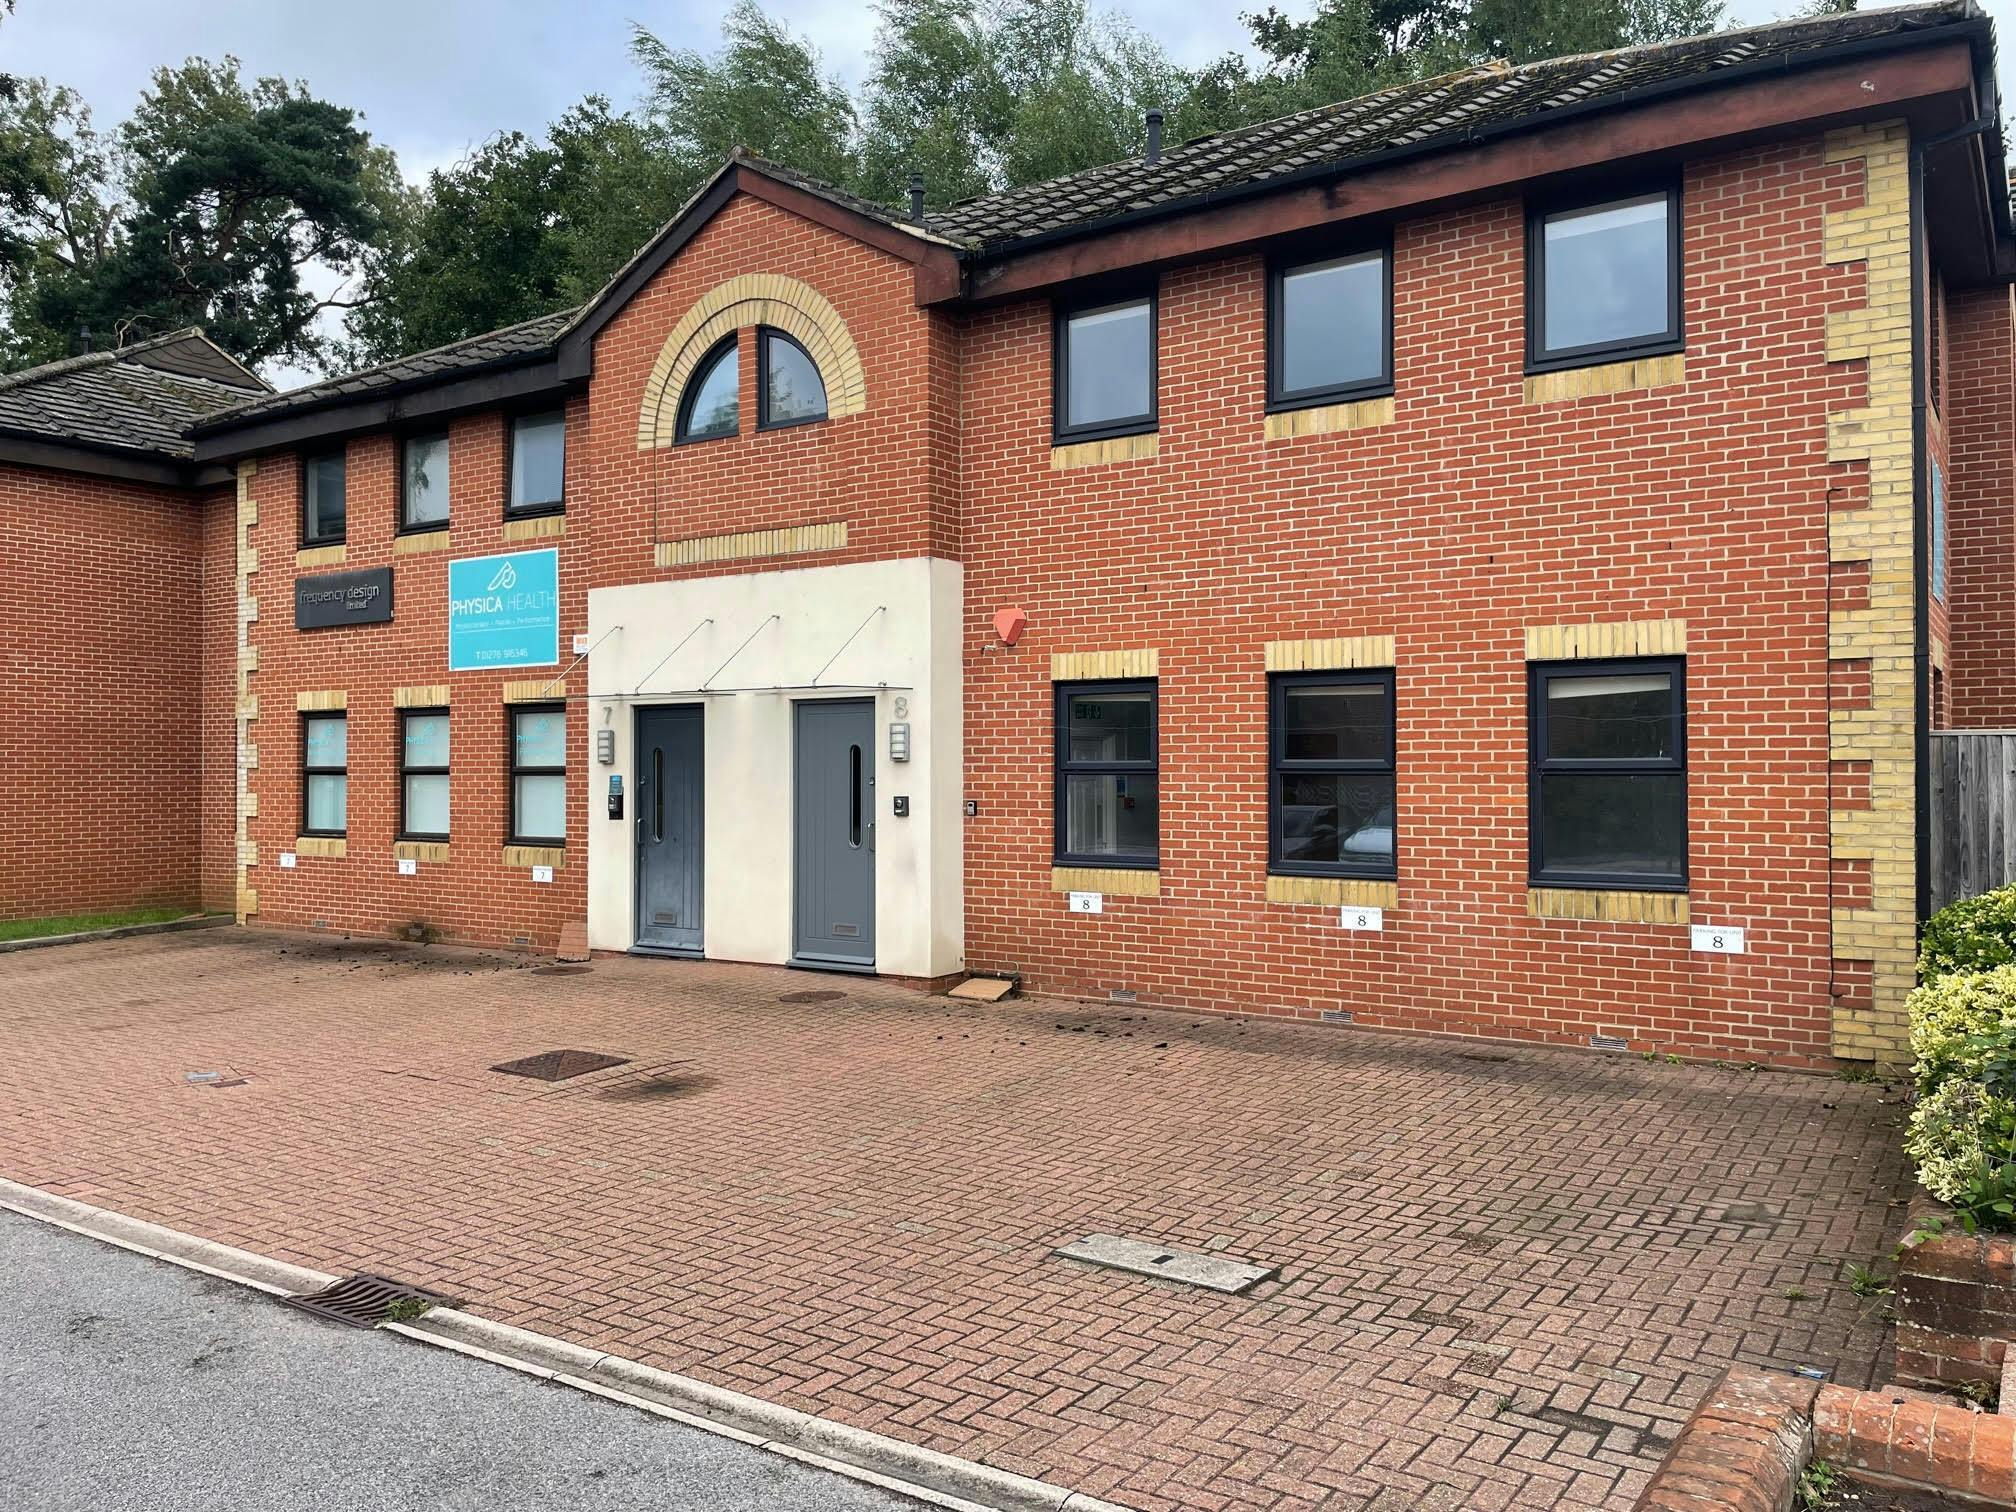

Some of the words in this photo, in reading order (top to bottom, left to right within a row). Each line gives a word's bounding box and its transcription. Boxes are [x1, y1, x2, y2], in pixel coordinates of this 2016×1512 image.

[300, 590, 346, 605] frequency
[347, 584, 379, 600] design
[452, 596, 503, 616] PHYSICA
[507, 591, 556, 611] HEALTH
[603, 706, 612, 724] 7
[894, 697, 908, 719] 8
[1083, 899, 1090, 910] 8
[1358, 915, 1367, 926] 8
[1713, 936, 1723, 948] 8
